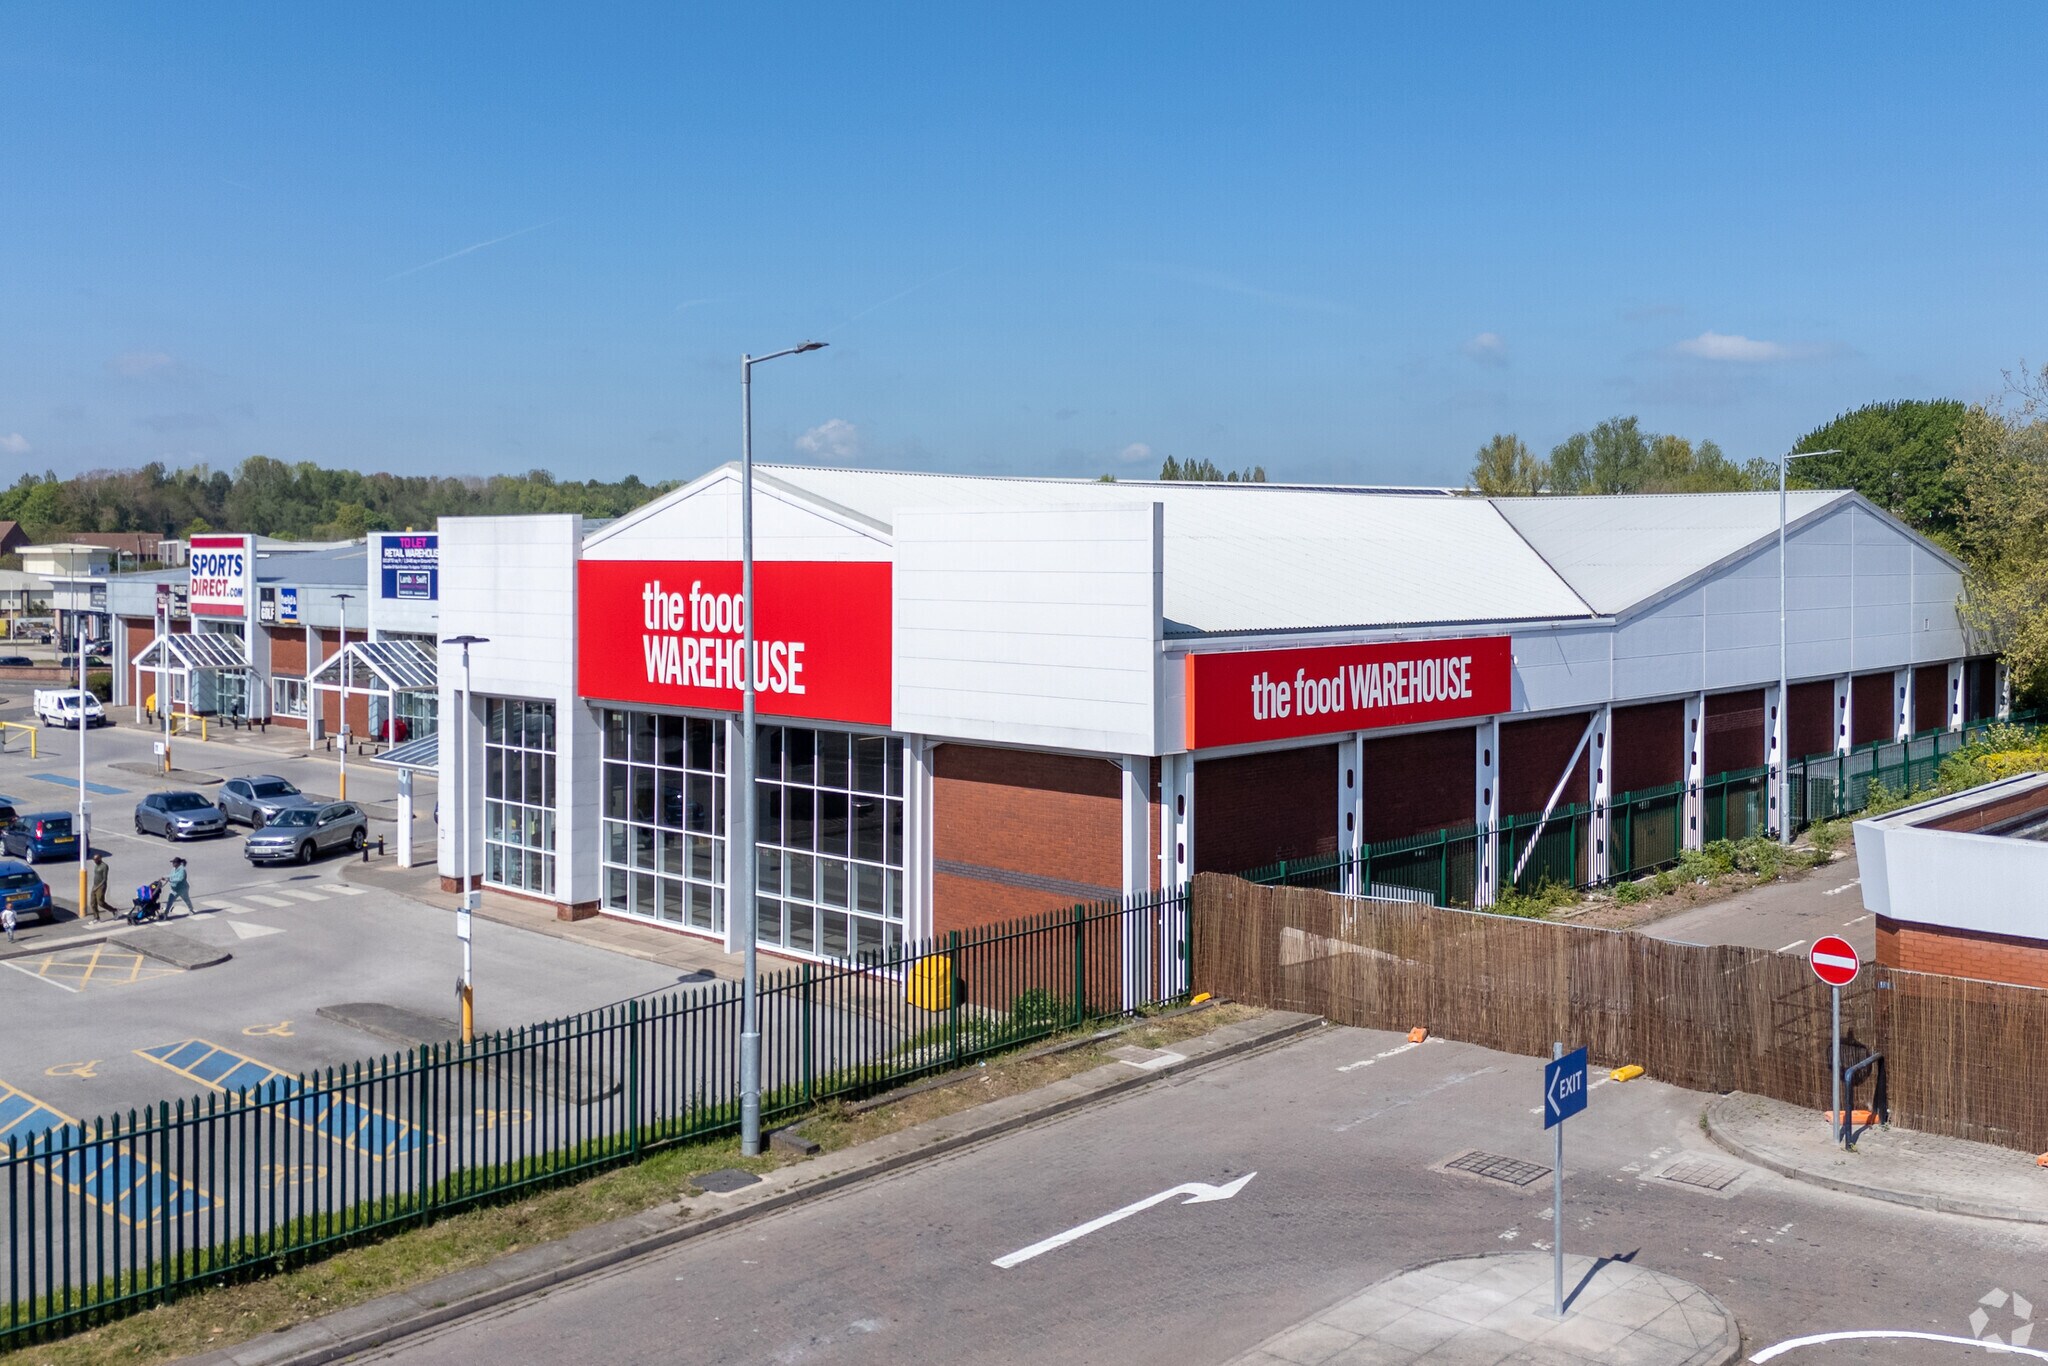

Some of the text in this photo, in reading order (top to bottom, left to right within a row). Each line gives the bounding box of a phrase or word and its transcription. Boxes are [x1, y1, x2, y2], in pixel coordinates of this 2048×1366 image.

[384, 548, 439, 558] RETAIL WAREHOUS
[400, 537, 427, 548] TO LET
[191, 554, 243, 577] SPORTS
[261, 607, 275, 620] GOLF
[642, 580, 684, 631] the
[642, 634, 806, 695] WAREHOUSE
[1251, 656, 1472, 721] the food WAREHOUSE
[1560, 1070, 1582, 1099] EXIT
